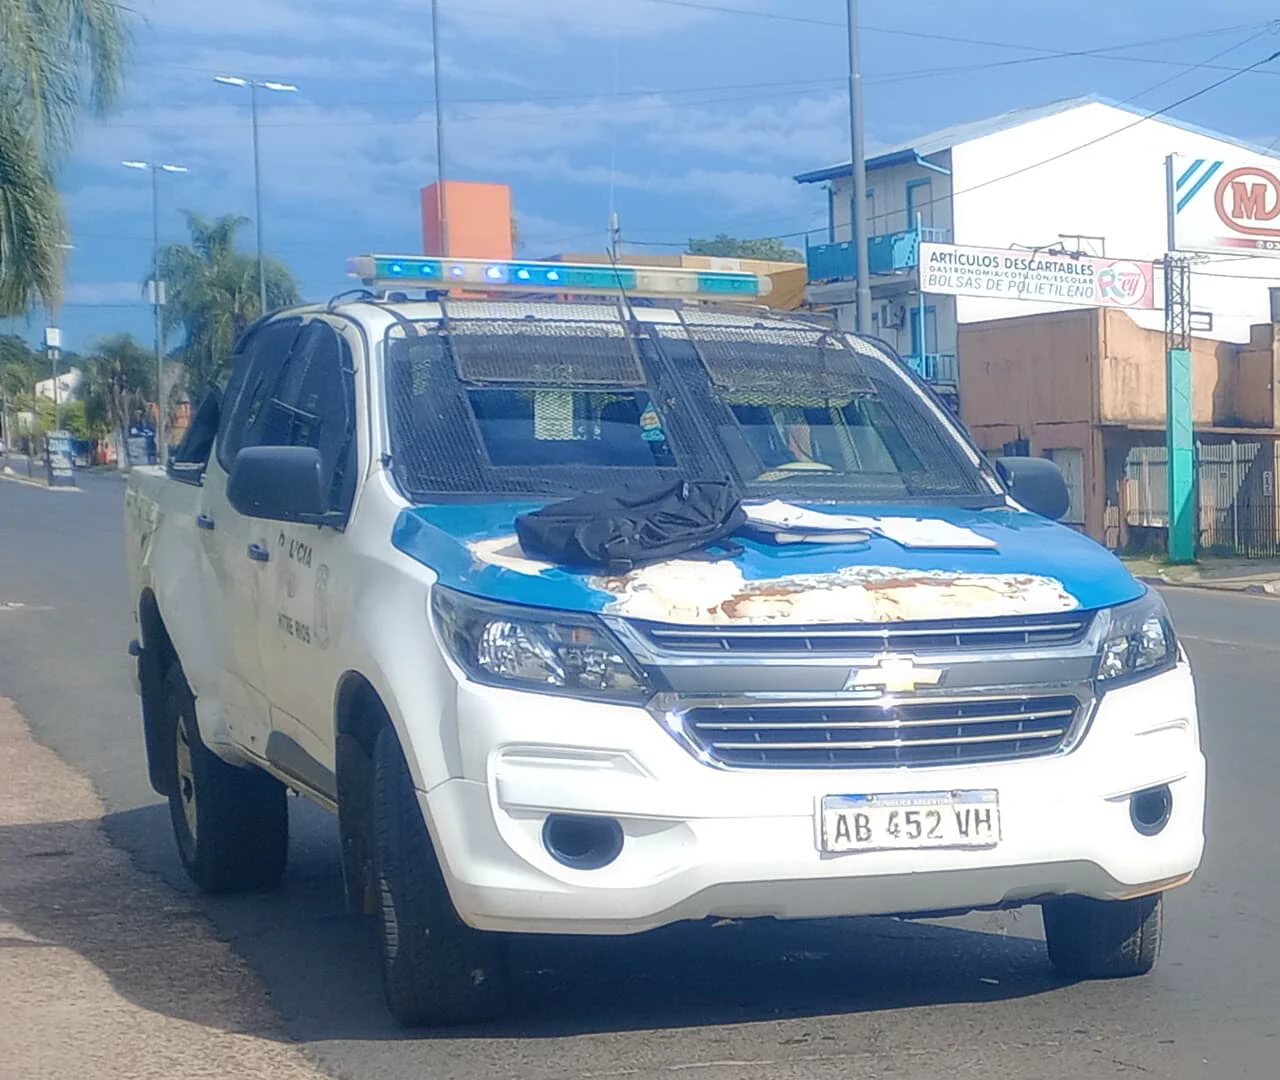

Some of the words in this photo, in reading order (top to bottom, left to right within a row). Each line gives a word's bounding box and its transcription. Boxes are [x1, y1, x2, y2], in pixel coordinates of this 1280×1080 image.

[929, 249, 999, 269] ARTÍCULOS
[1004, 257, 1094, 277] DESCARTABLES
[928, 273, 982, 290] BOLSAS
[986, 278, 1004, 292] DE
[1007, 280, 1094, 299] POLIETILENO
[834, 813, 873, 844] AB
[885, 809, 944, 841] 452
[955, 808, 993, 838] VH
